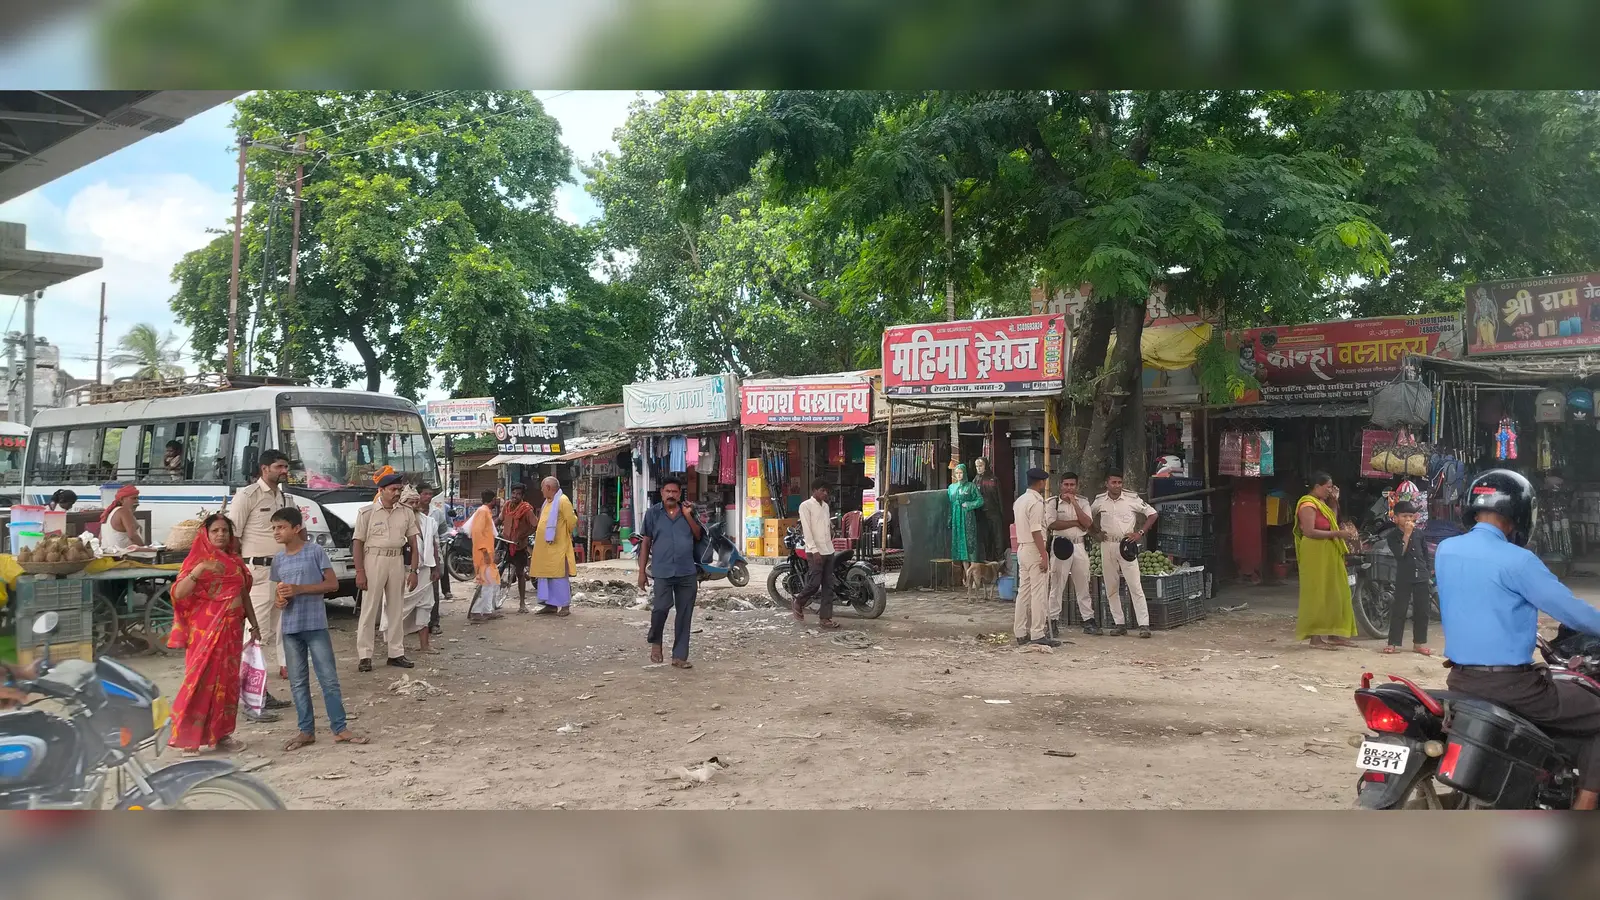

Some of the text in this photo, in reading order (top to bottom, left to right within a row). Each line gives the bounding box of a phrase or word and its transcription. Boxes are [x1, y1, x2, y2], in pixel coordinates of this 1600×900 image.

[1501, 289, 1535, 326] श्री
[1538, 288, 1578, 311] राम
[890, 330, 970, 381] महिमा
[974, 331, 1039, 379] ड्रेसेज
[1266, 336, 1429, 380] कान्हा वस्त्रालय
[745, 388, 870, 415] प्रकाश वस्त्रालय
[288, 412, 415, 432] AVKUSH
[1362, 756, 1399, 769] 8511
[1364, 748, 1402, 759] BR-22X
